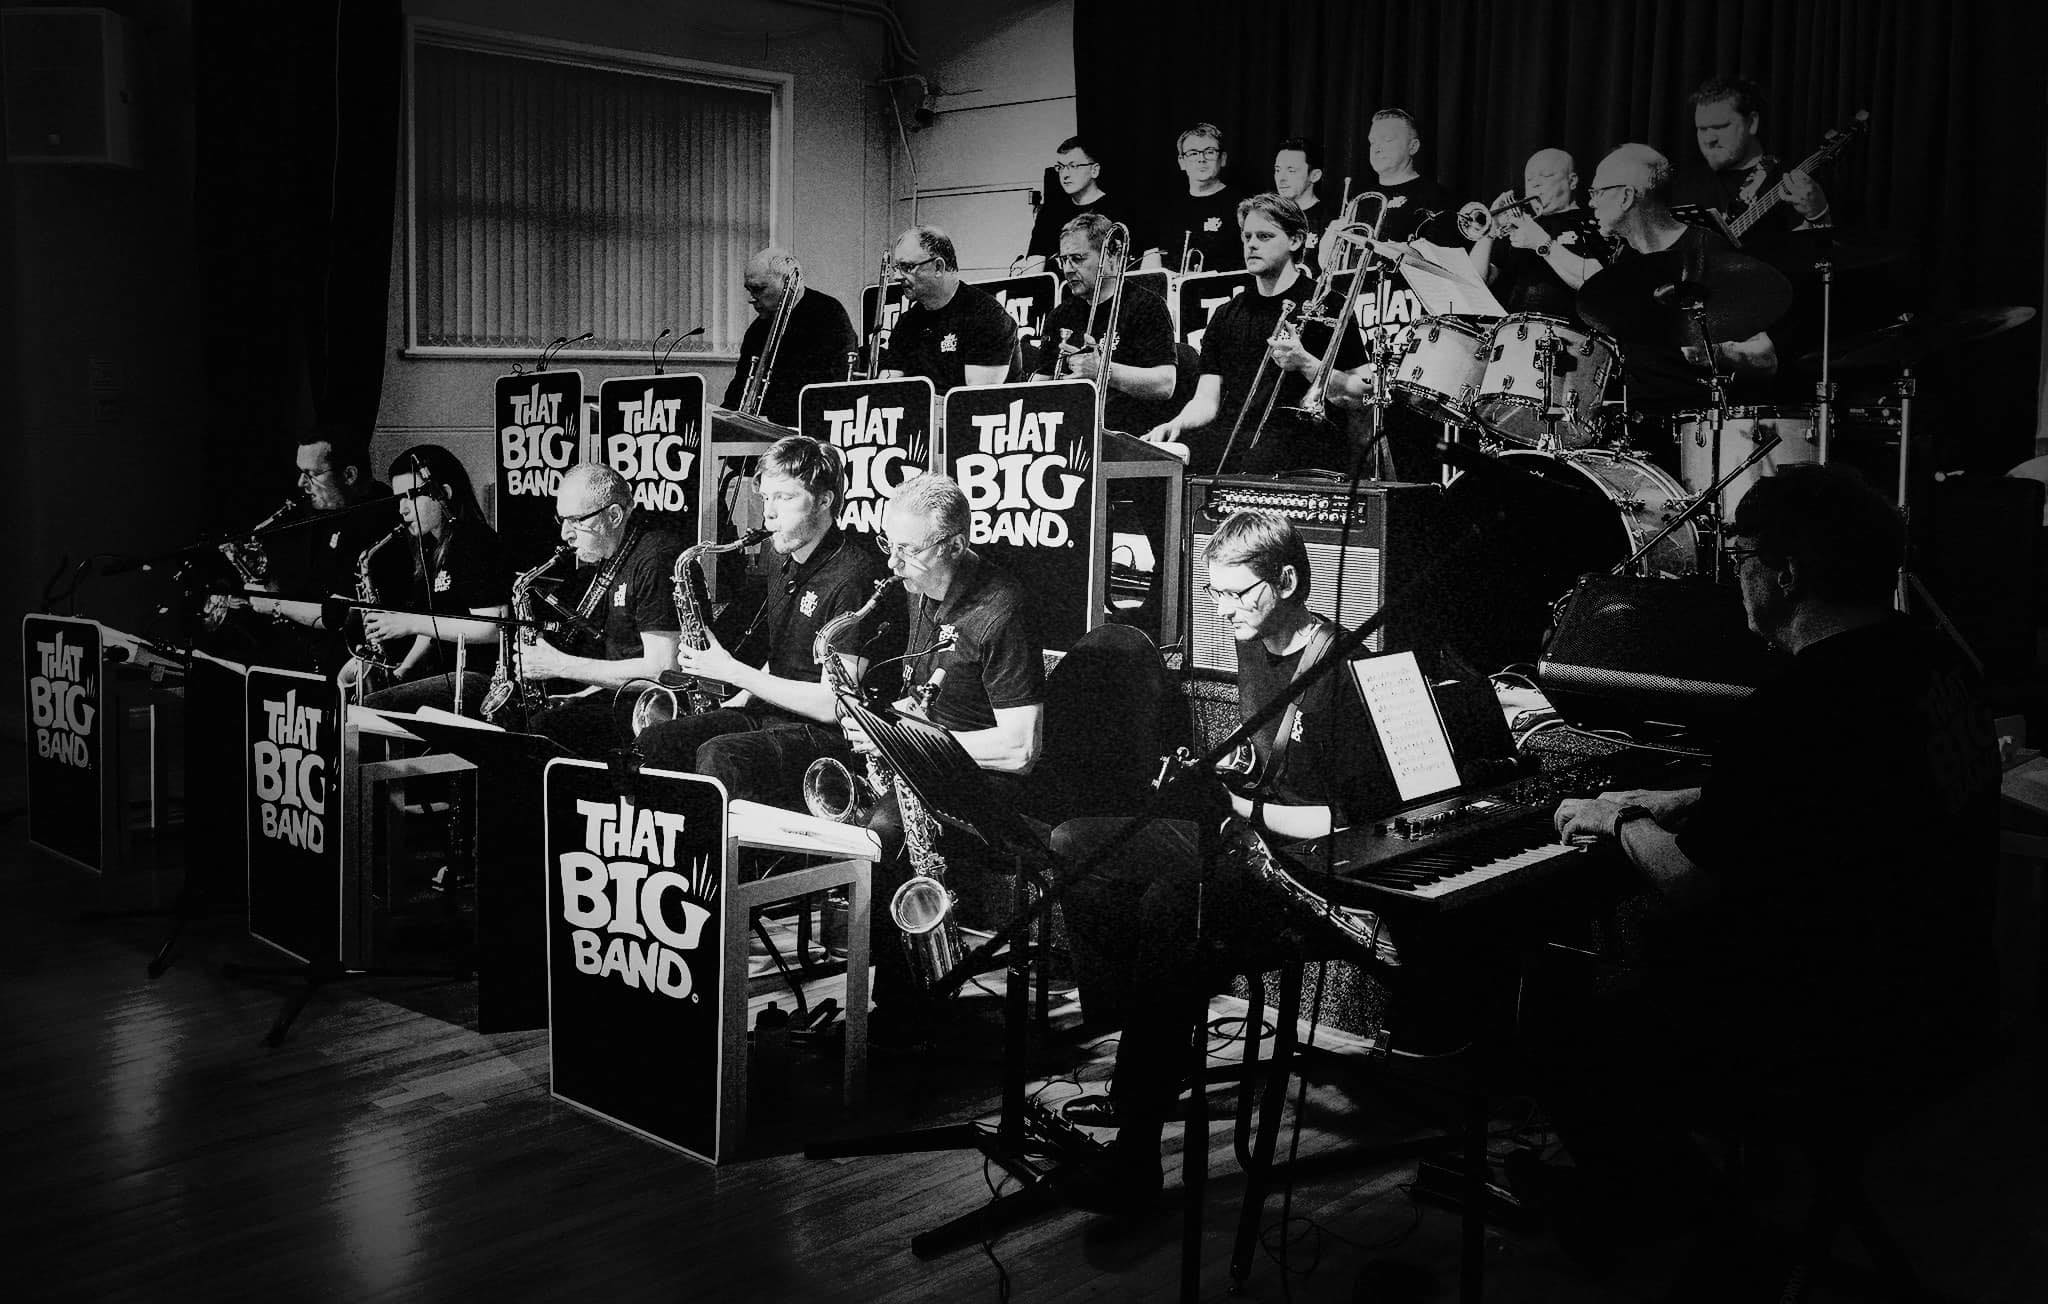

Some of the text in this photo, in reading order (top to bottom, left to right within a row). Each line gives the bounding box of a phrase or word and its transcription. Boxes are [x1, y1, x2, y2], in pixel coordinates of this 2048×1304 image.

[510, 382, 563, 425] THAT
[618, 387, 682, 434] THAT
[823, 394, 905, 448] THAT
[971, 398, 1065, 455] THAT
[501, 425, 575, 469] BIG
[607, 432, 696, 482] BIG
[627, 478, 685, 512] AND
[955, 453, 1086, 511] BIG
[36, 630, 84, 682] THAT
[30, 675, 96, 736] BIG
[263, 689, 322, 751] THAT
[253, 740, 326, 815] BIG
[260, 803, 324, 854] BAND
[576, 795, 686, 868] THAT
[559, 851, 712, 950] BIG
